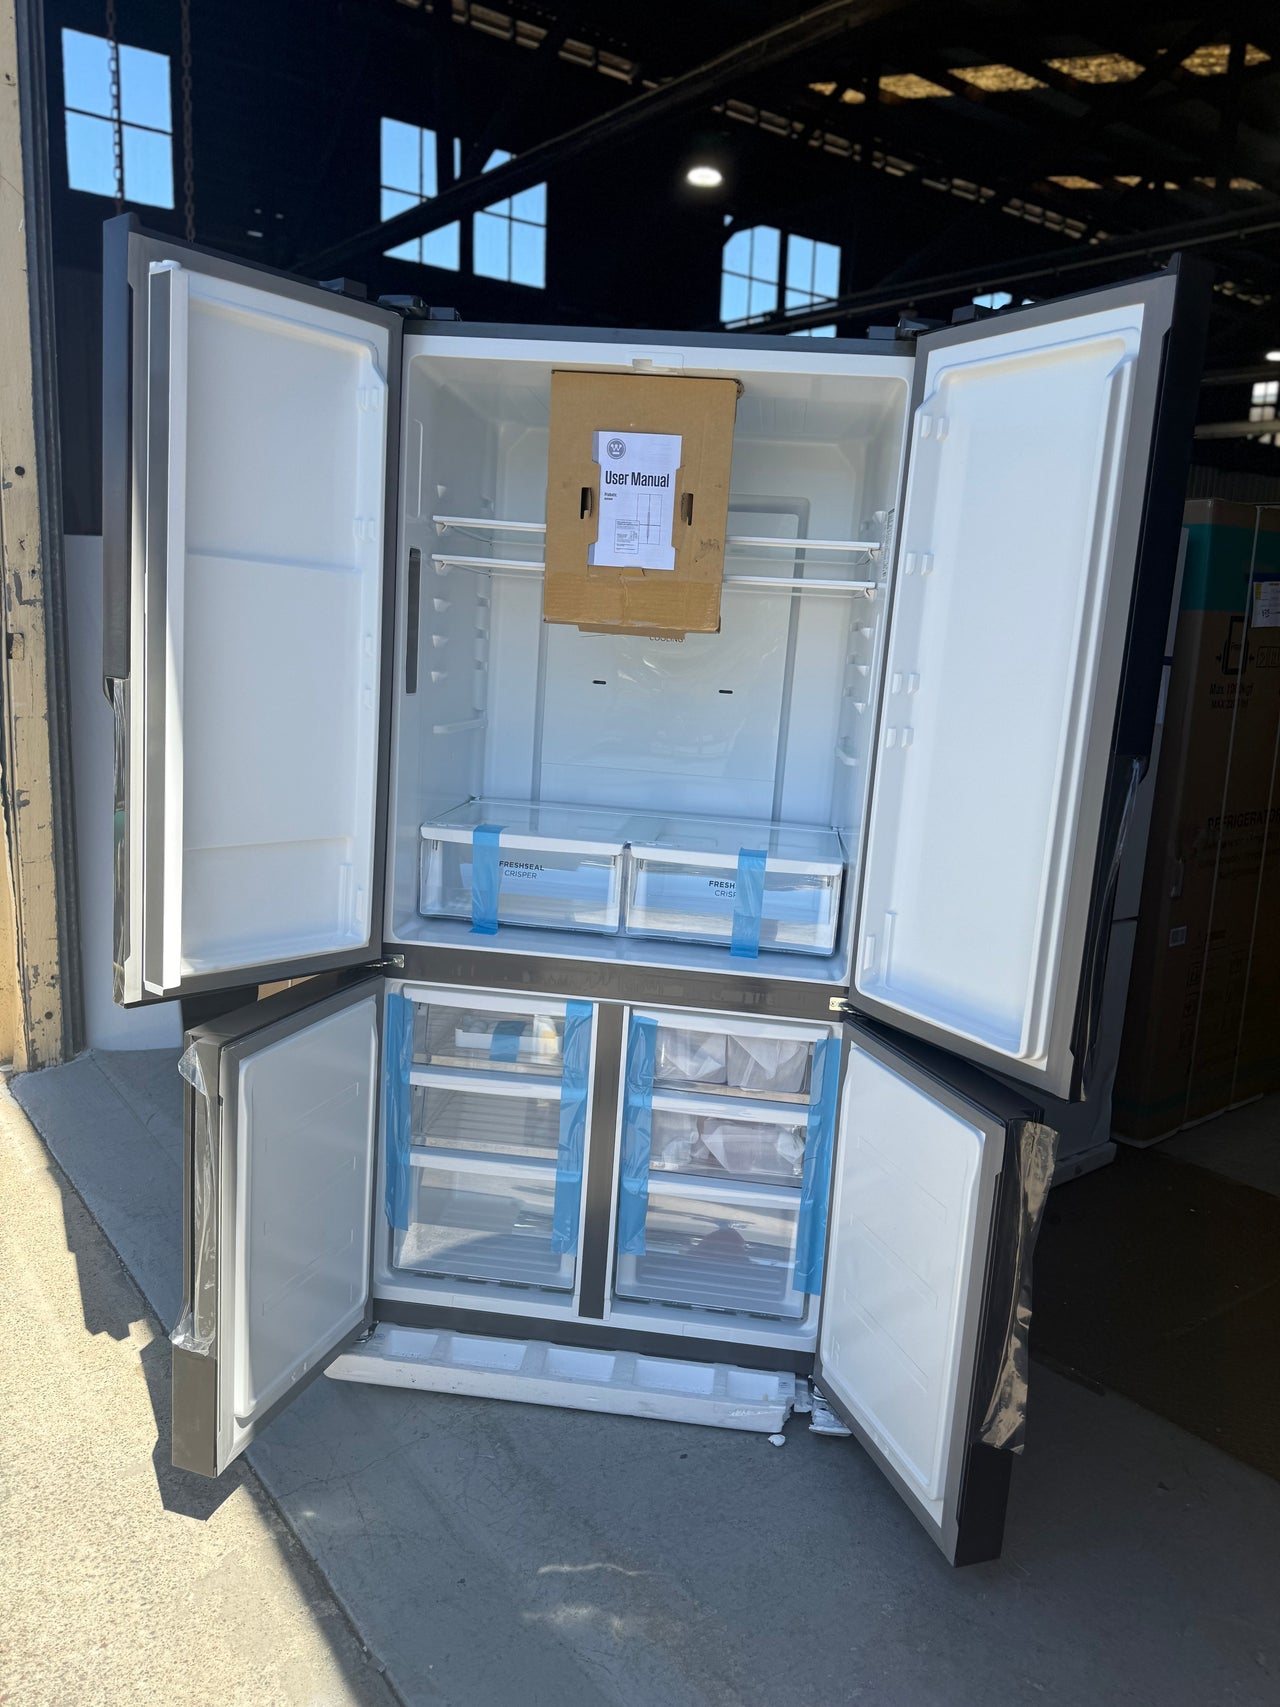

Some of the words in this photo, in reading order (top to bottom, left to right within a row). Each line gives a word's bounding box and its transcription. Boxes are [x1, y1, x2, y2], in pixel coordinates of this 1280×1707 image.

[605, 470, 629, 486] User
[631, 472, 670, 488] Manual
[498, 860, 545, 872] FRESHSEAL
[504, 869, 538, 880] CRISPER
[708, 880, 736, 889] FRESH
